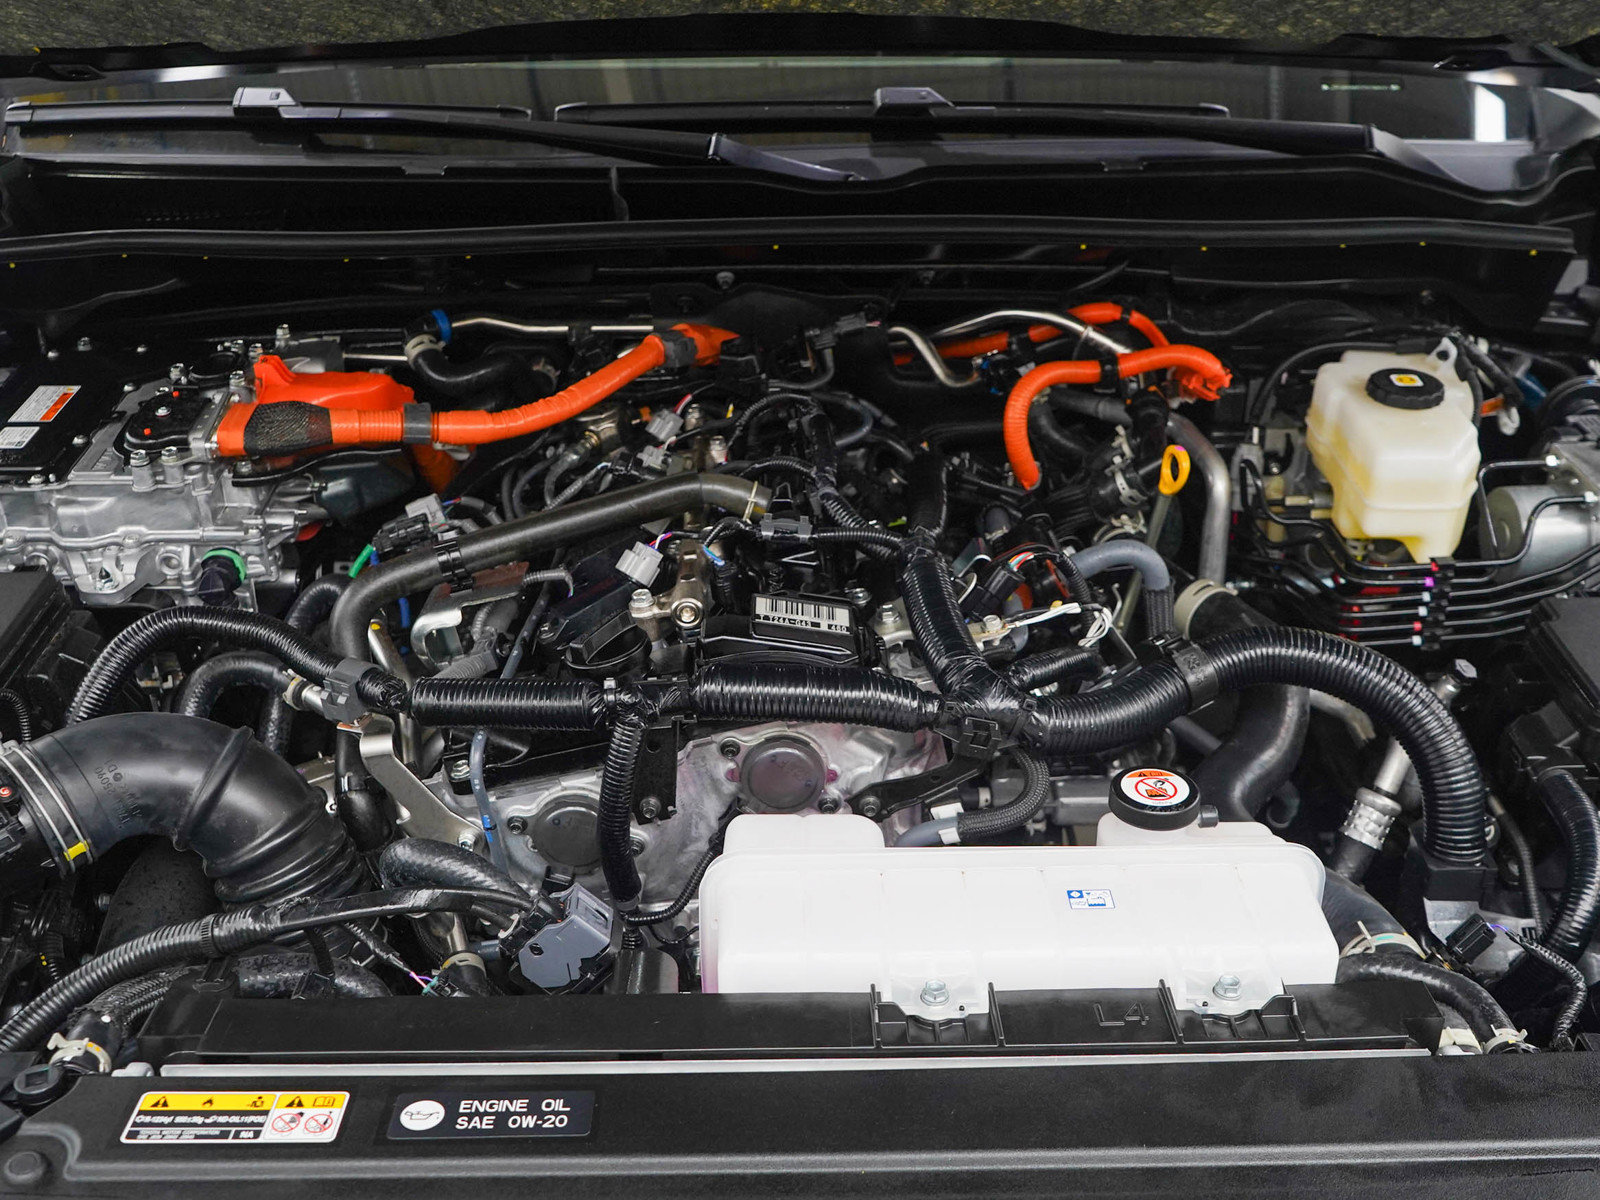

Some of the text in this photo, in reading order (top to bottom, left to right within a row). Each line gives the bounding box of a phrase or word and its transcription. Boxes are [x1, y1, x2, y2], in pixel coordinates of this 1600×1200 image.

[1093, 1001, 1150, 1026] L4
[459, 1098, 571, 1112] ENGINE OIL
[455, 1115, 568, 1130] SAE 0W-20
